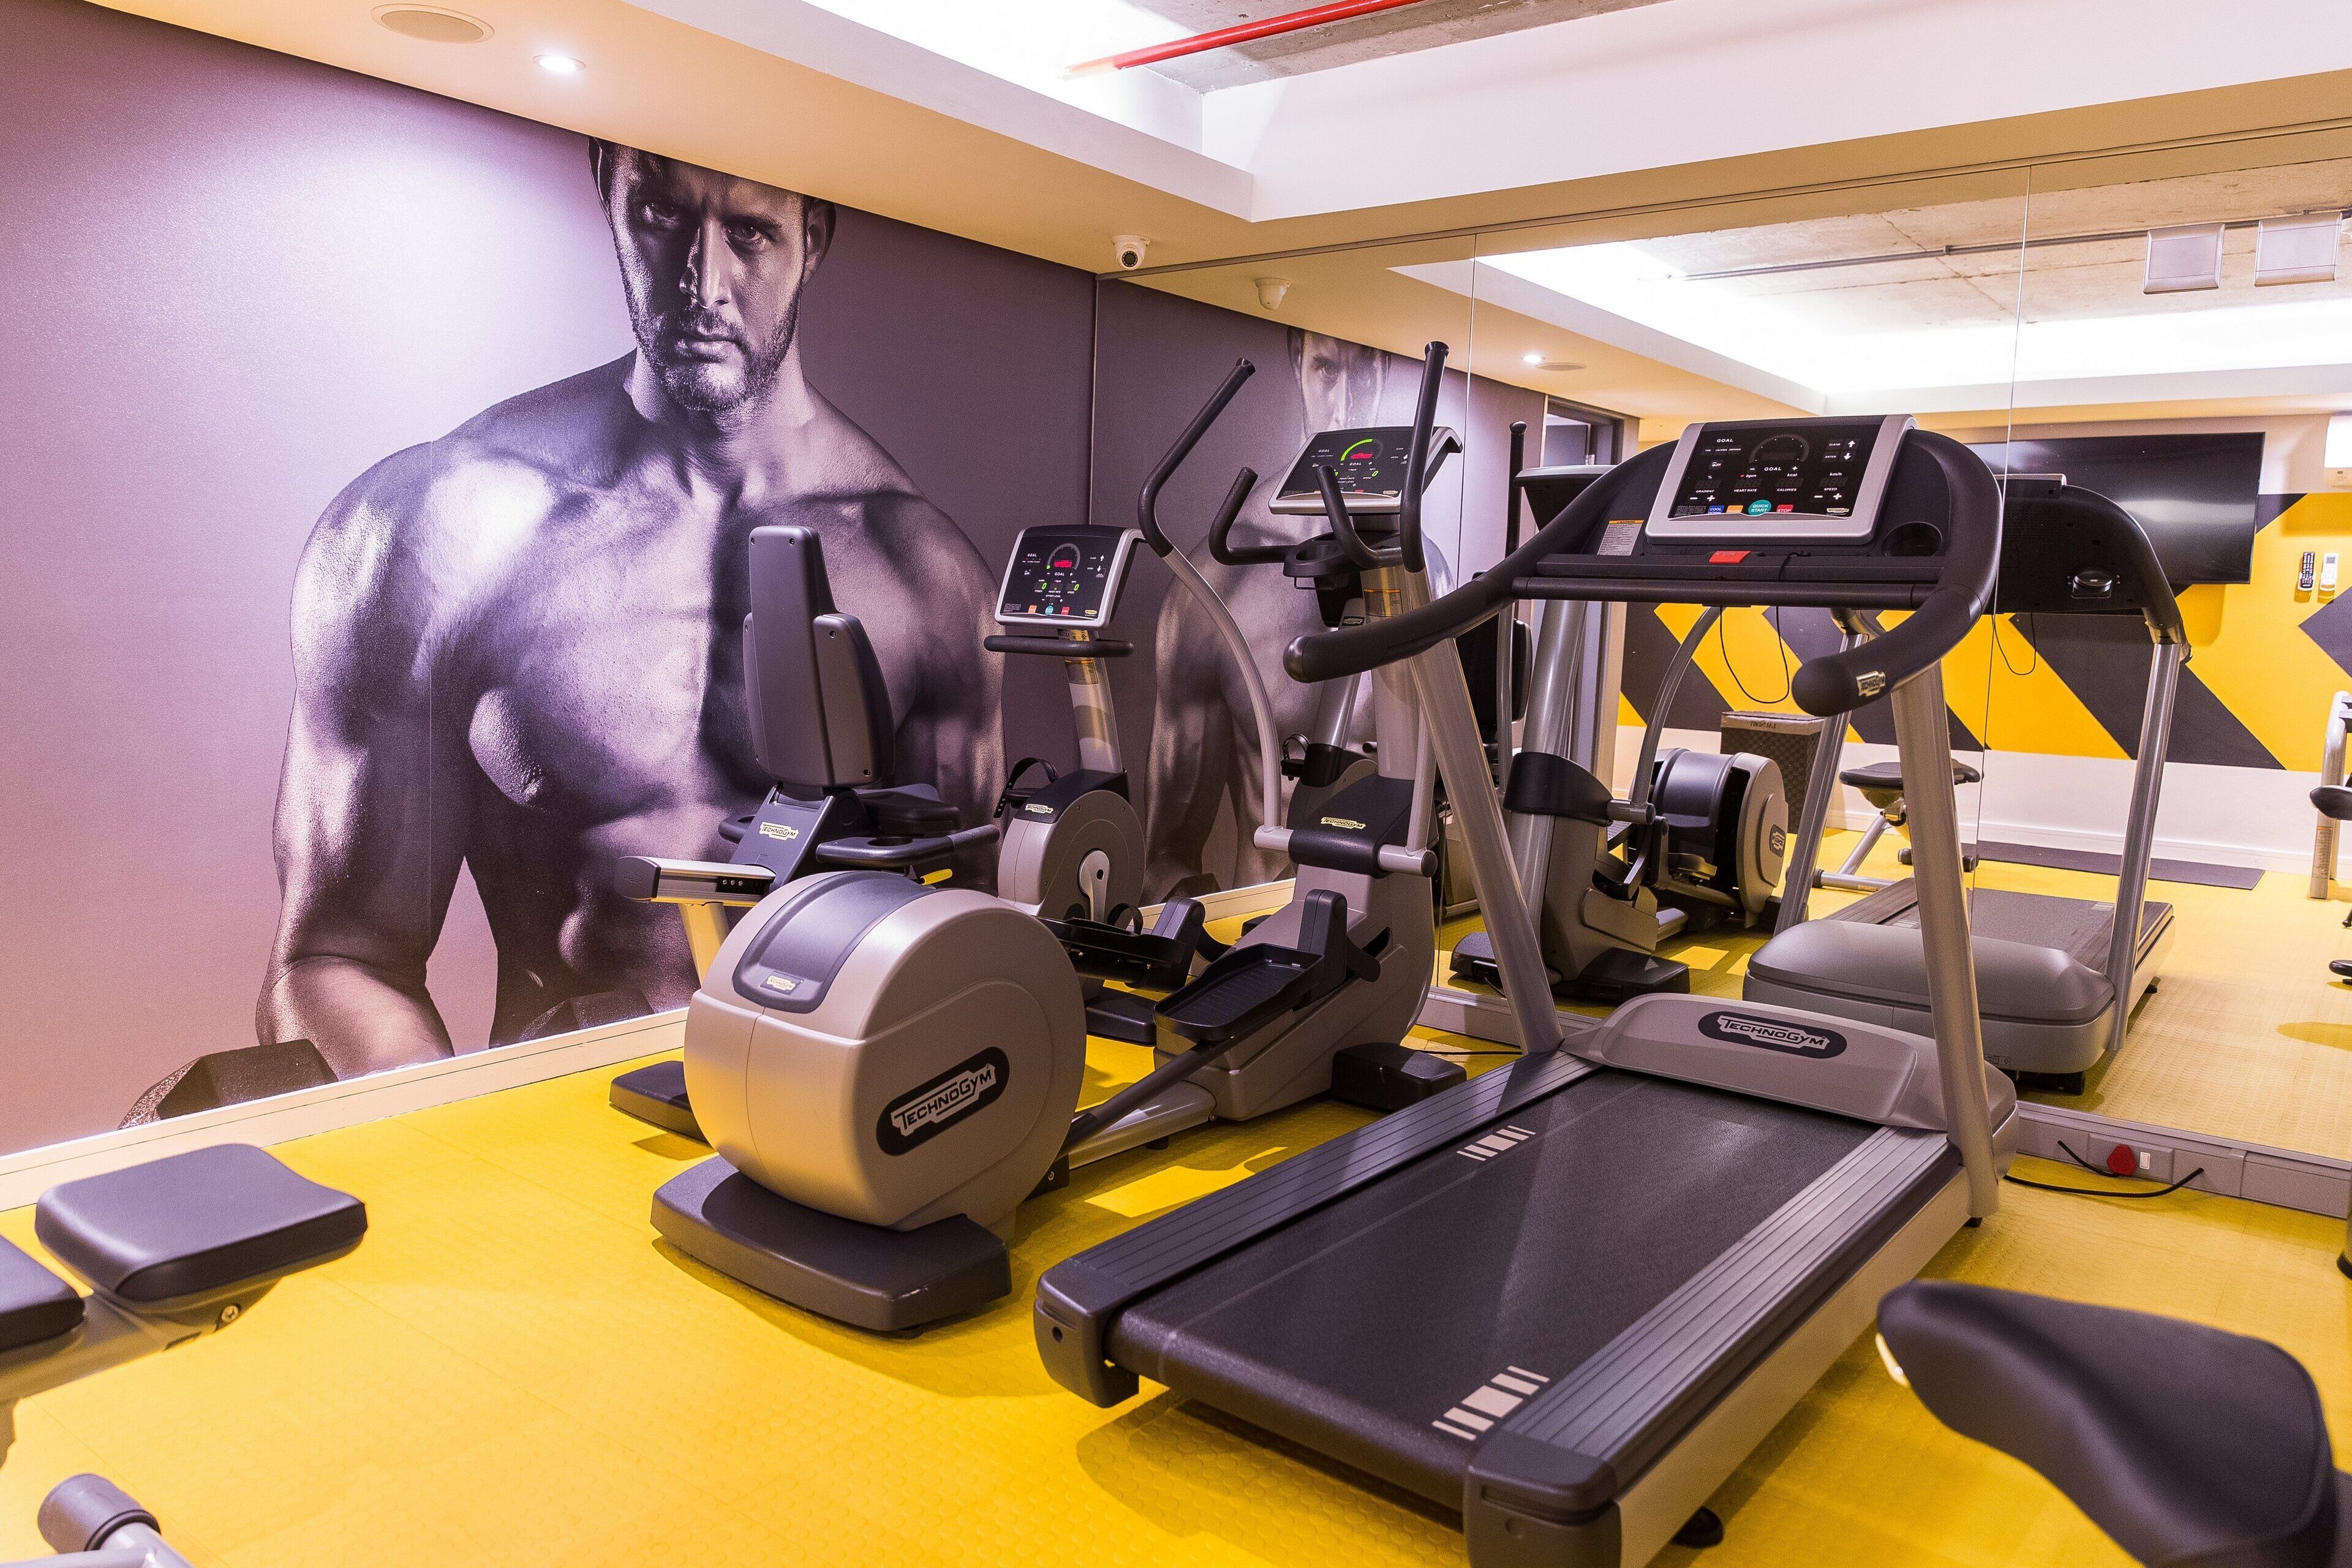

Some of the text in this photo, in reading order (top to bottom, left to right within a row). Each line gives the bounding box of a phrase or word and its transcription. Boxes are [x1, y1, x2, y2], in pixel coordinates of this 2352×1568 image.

[762, 824, 796, 837] TECHNOGYM
[1323, 818, 1363, 828] TECHNOGYM
[1721, 1017, 1826, 1046] TECHNOGYM
[892, 1068, 993, 1131] TECHNOGYM
